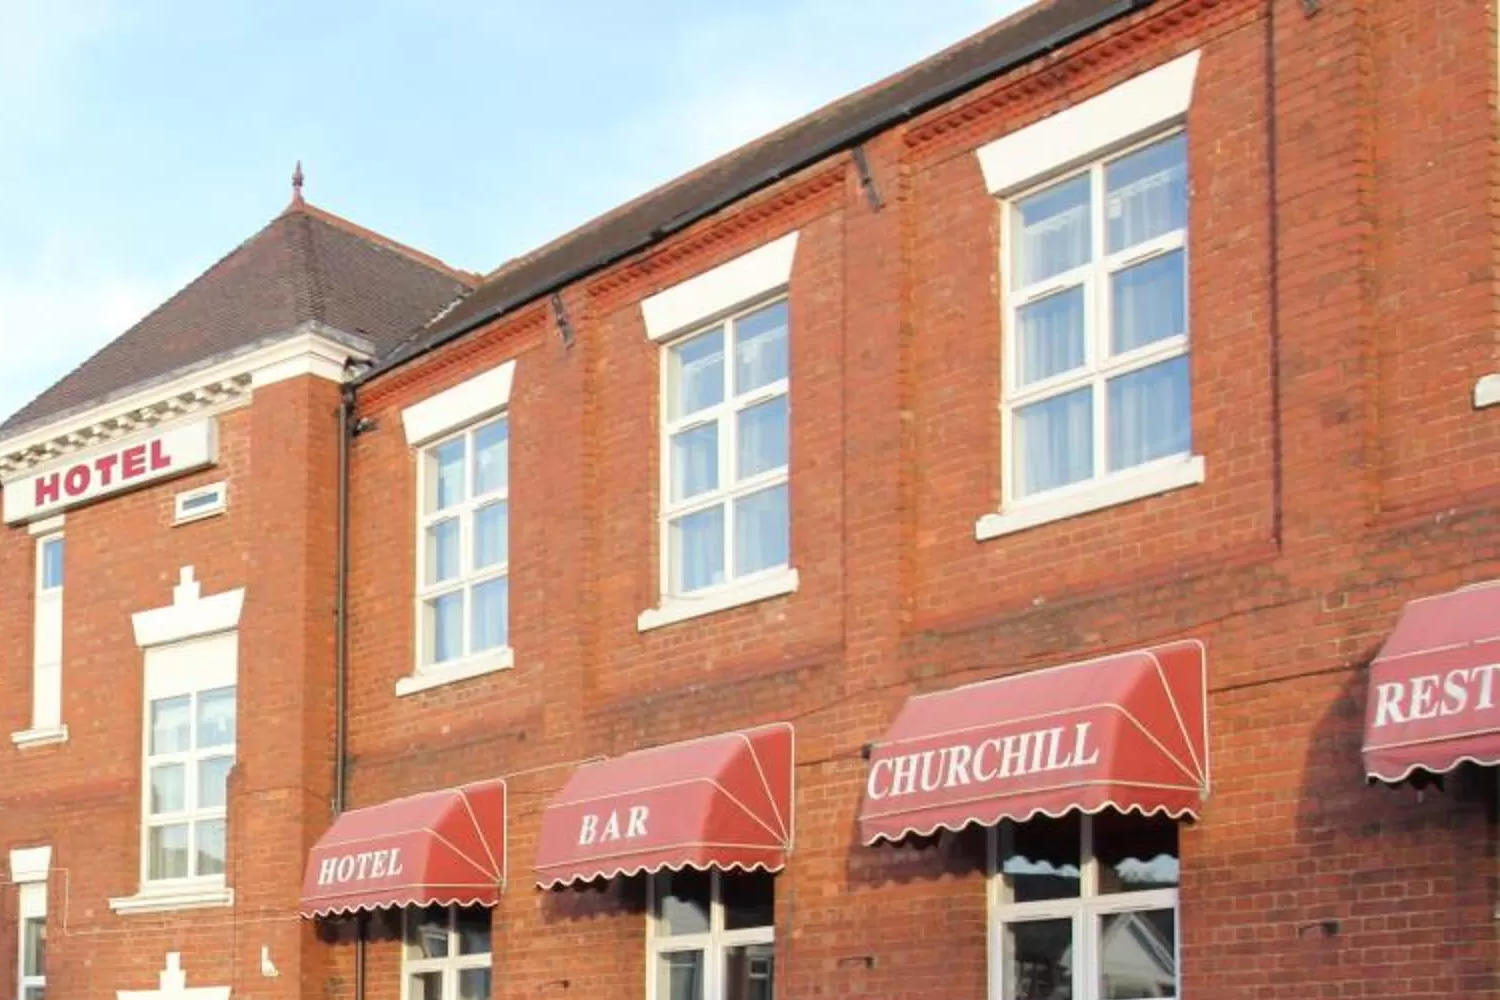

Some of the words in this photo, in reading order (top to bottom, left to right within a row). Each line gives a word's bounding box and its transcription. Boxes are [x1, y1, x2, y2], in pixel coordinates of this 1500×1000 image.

[34, 438, 172, 507] HOTEL
[866, 721, 1100, 800] CHURCHILL
[577, 805, 650, 846] BAR
[317, 847, 403, 886] HOTEL
